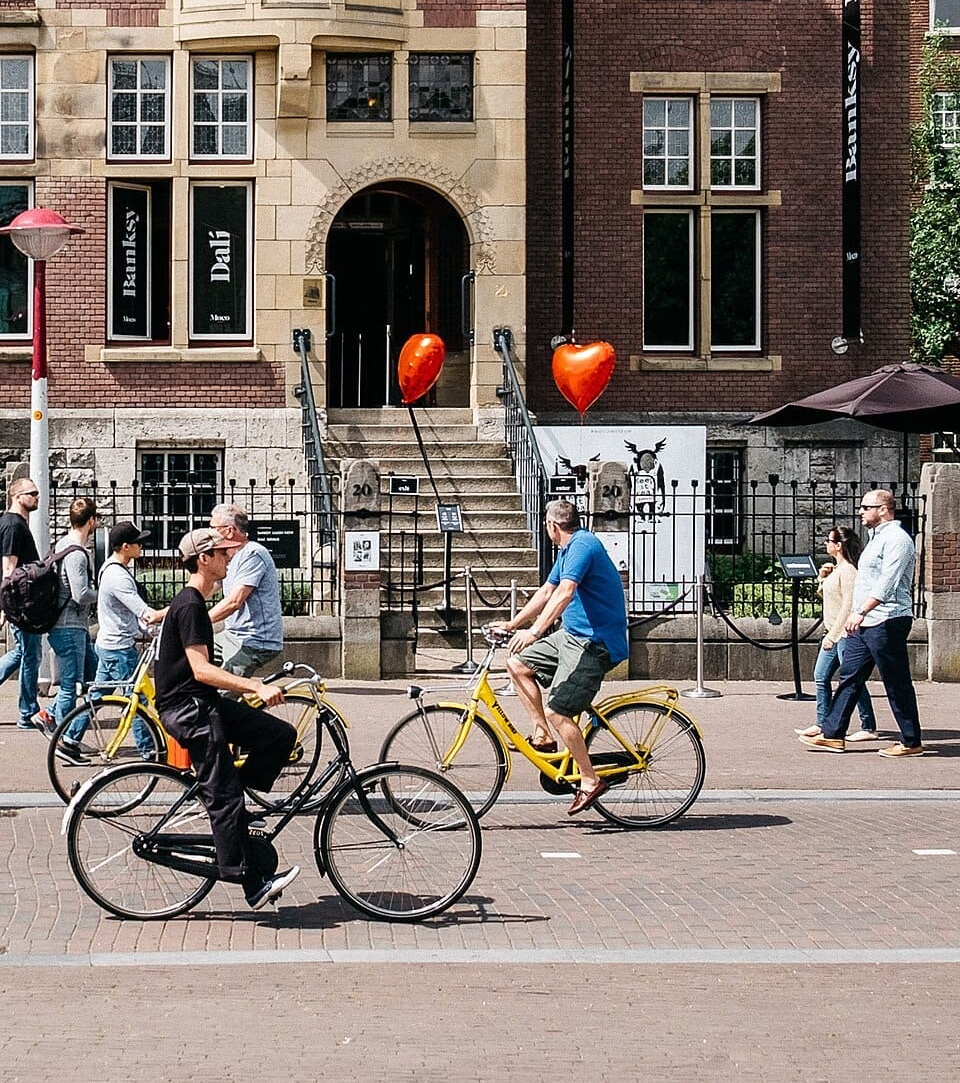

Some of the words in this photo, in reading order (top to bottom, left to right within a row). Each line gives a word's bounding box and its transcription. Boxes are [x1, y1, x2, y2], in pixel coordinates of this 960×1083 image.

[844, 40, 860, 183] Banksy
[122, 206, 140, 298] Banksy
[353, 484, 372, 497] 20
[602, 485, 621, 498] 20
